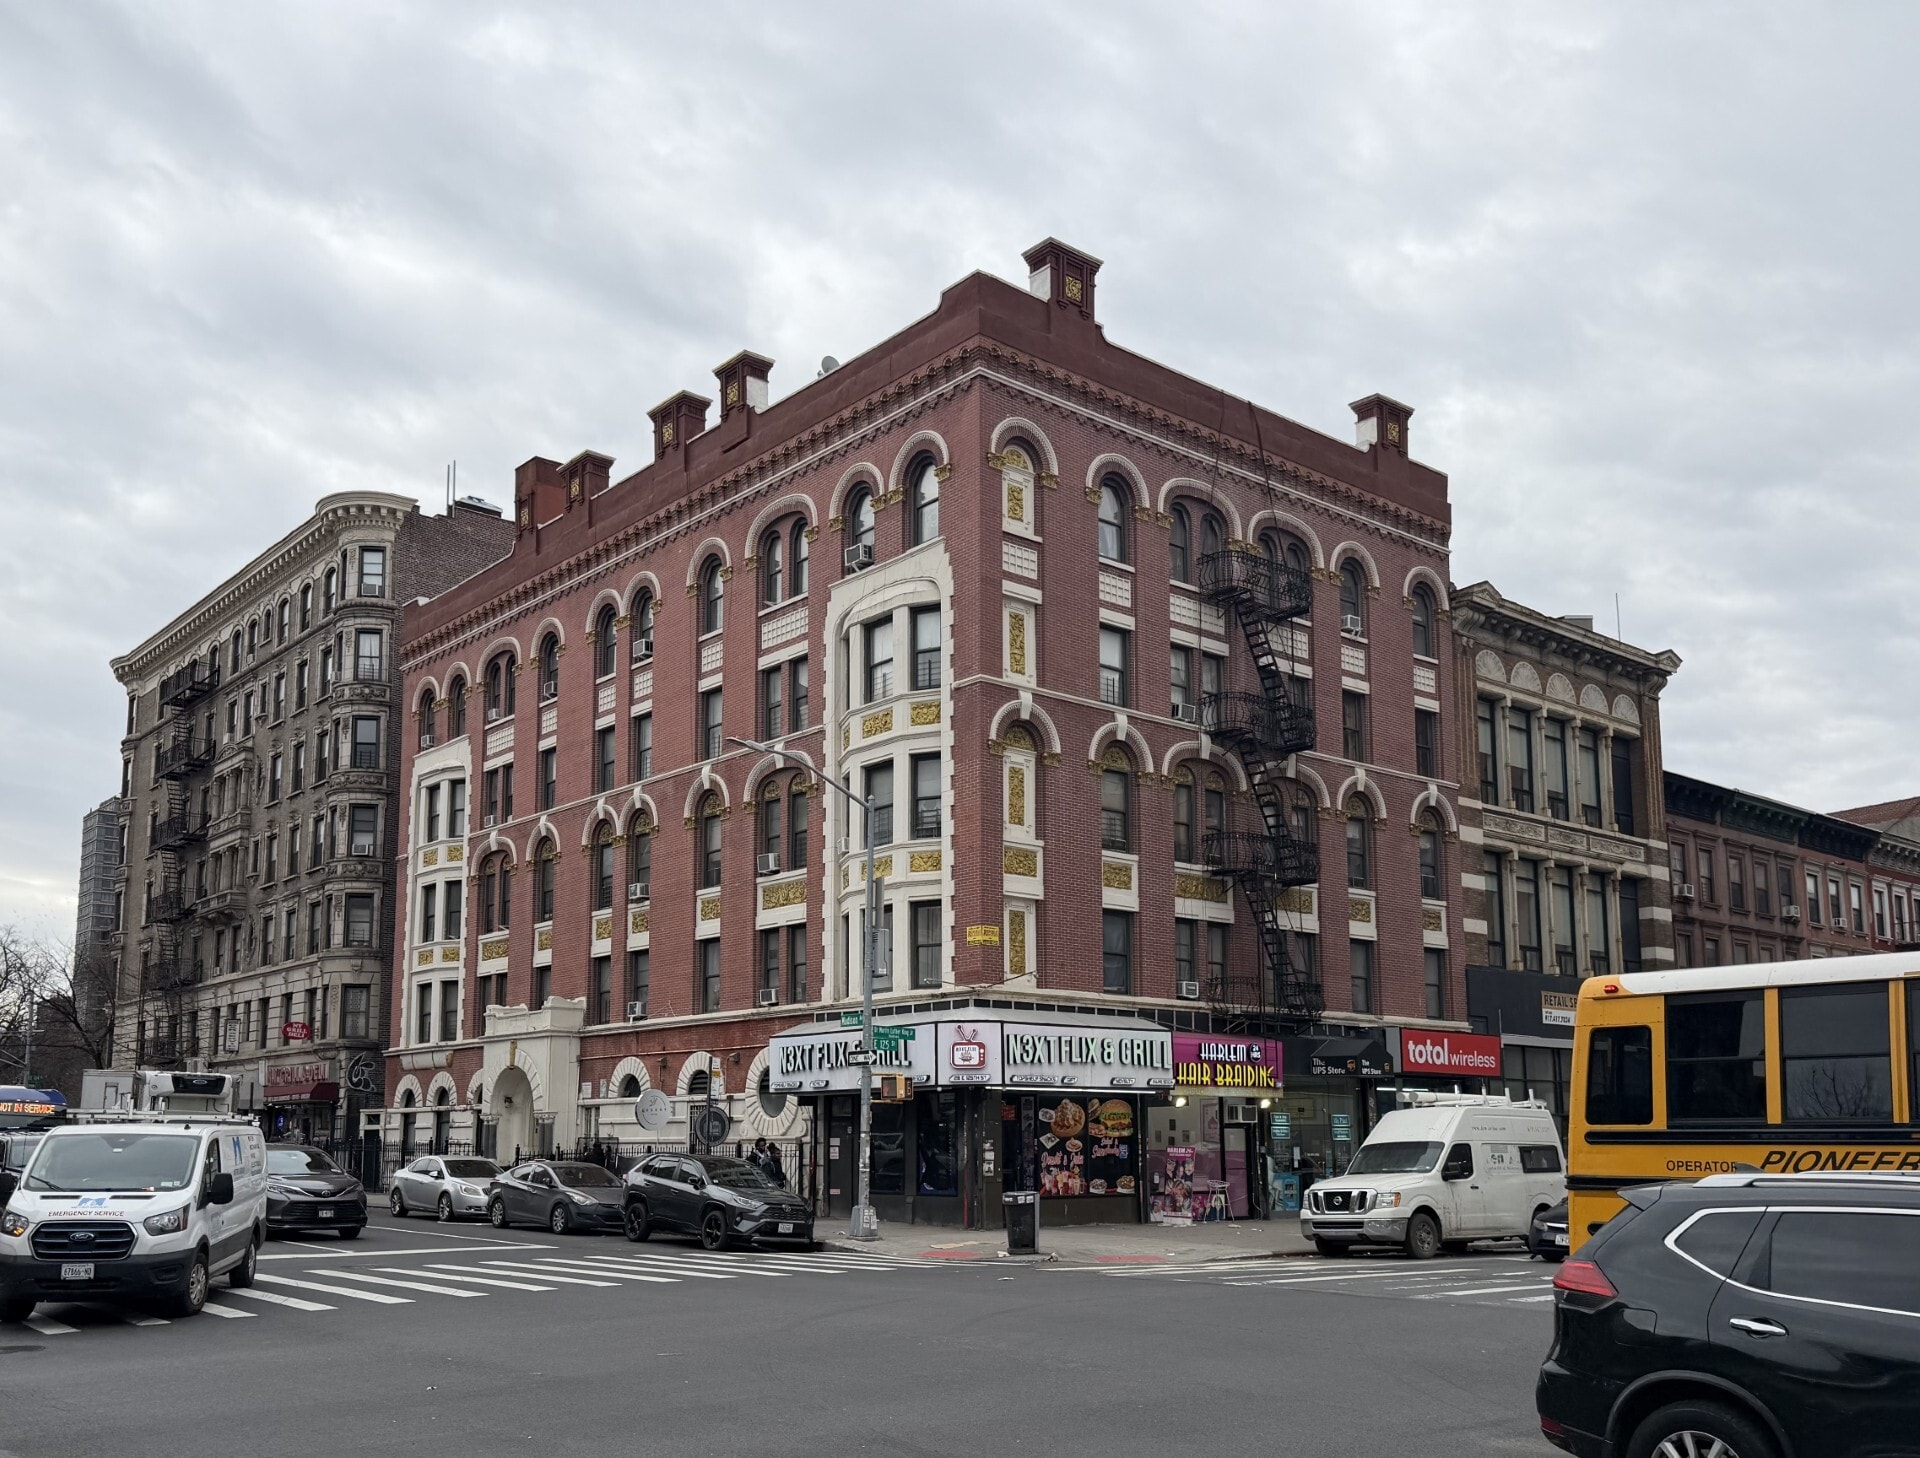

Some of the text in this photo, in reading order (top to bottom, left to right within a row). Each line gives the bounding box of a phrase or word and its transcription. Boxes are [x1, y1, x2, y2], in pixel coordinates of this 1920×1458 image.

[1544, 995, 1568, 1007] RETAIL
[874, 1040, 878, 1050] E
[880, 1040, 889, 1050] 125
[1008, 1034, 1172, 1069] N3XT FLIX & GRILL
[779, 1044, 812, 1075] N3XT
[816, 1041, 848, 1070] FLIX
[1200, 1043, 1247, 1062] HARLEM
[1408, 1038, 1496, 1068] total wireless
[1313, 1058, 1325, 1066] The
[1177, 1062, 1275, 1088] HAIR BRAIDING
[1313, 1066, 1345, 1075] UPS Store
[14, 1103, 23, 1113] IN
[24, 1104, 56, 1114] SERVICE
[1666, 1160, 1737, 1173] OPERATOR
